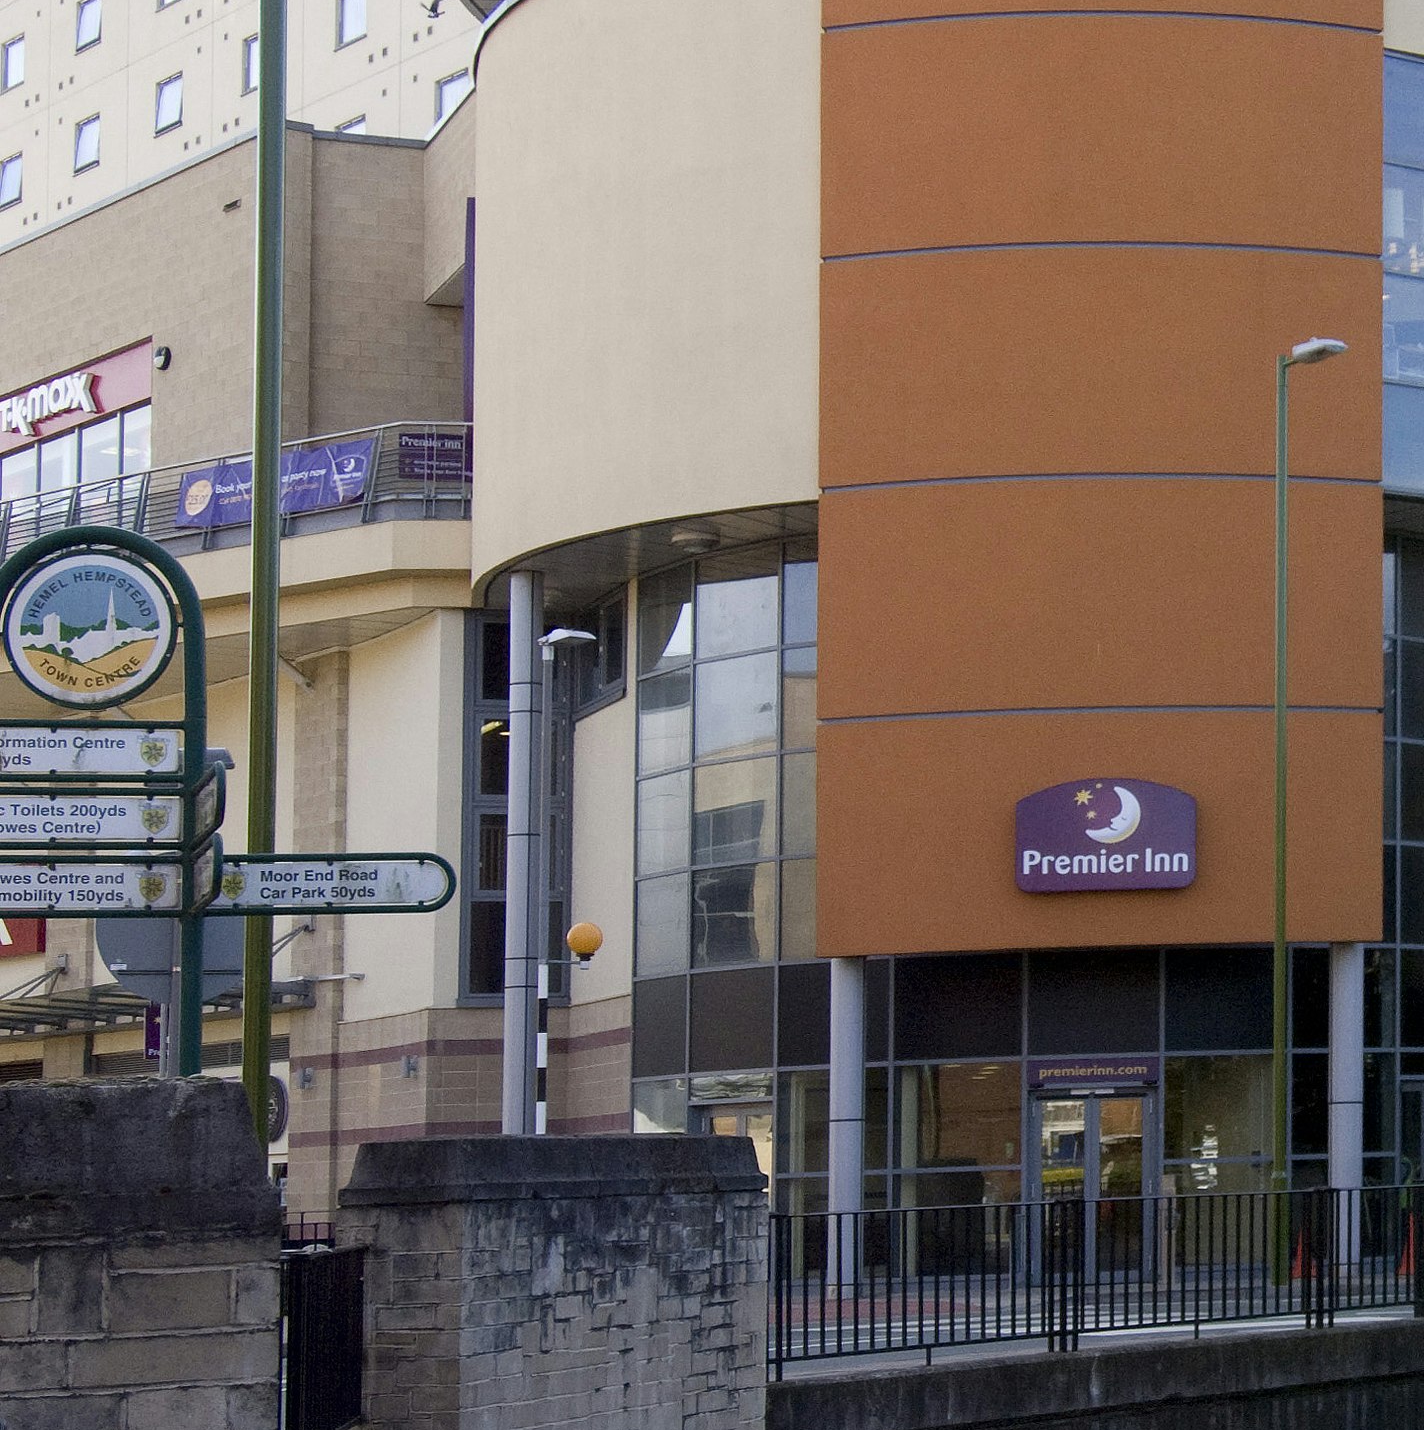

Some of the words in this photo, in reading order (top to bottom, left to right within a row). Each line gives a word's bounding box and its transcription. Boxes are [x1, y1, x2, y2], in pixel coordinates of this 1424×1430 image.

[28, 579, 69, 619] HEMEL
[73, 571, 152, 618] HEMPSTEAD
[39, 658, 78, 687] TOWN
[84, 656, 141, 688] CENTRE
[72, 736, 126, 749] Centre
[11, 804, 65, 817] Toilets
[70, 804, 127, 821] 200yds
[42, 821, 101, 835] Centre)
[1022, 849, 1139, 875] Premier
[1145, 847, 1190, 872] Inn
[36, 872, 91, 885] Centre
[94, 872, 125, 885] and
[260, 870, 300, 882] Moor
[304, 870, 334, 881] End
[338, 870, 378, 881] Road
[68, 889, 125, 905] 150yds
[260, 887, 287, 899] Car
[292, 887, 325, 898] Park
[330, 885, 376, 901] 50yds
[1039, 1066, 1148, 1080] premierinn.com
